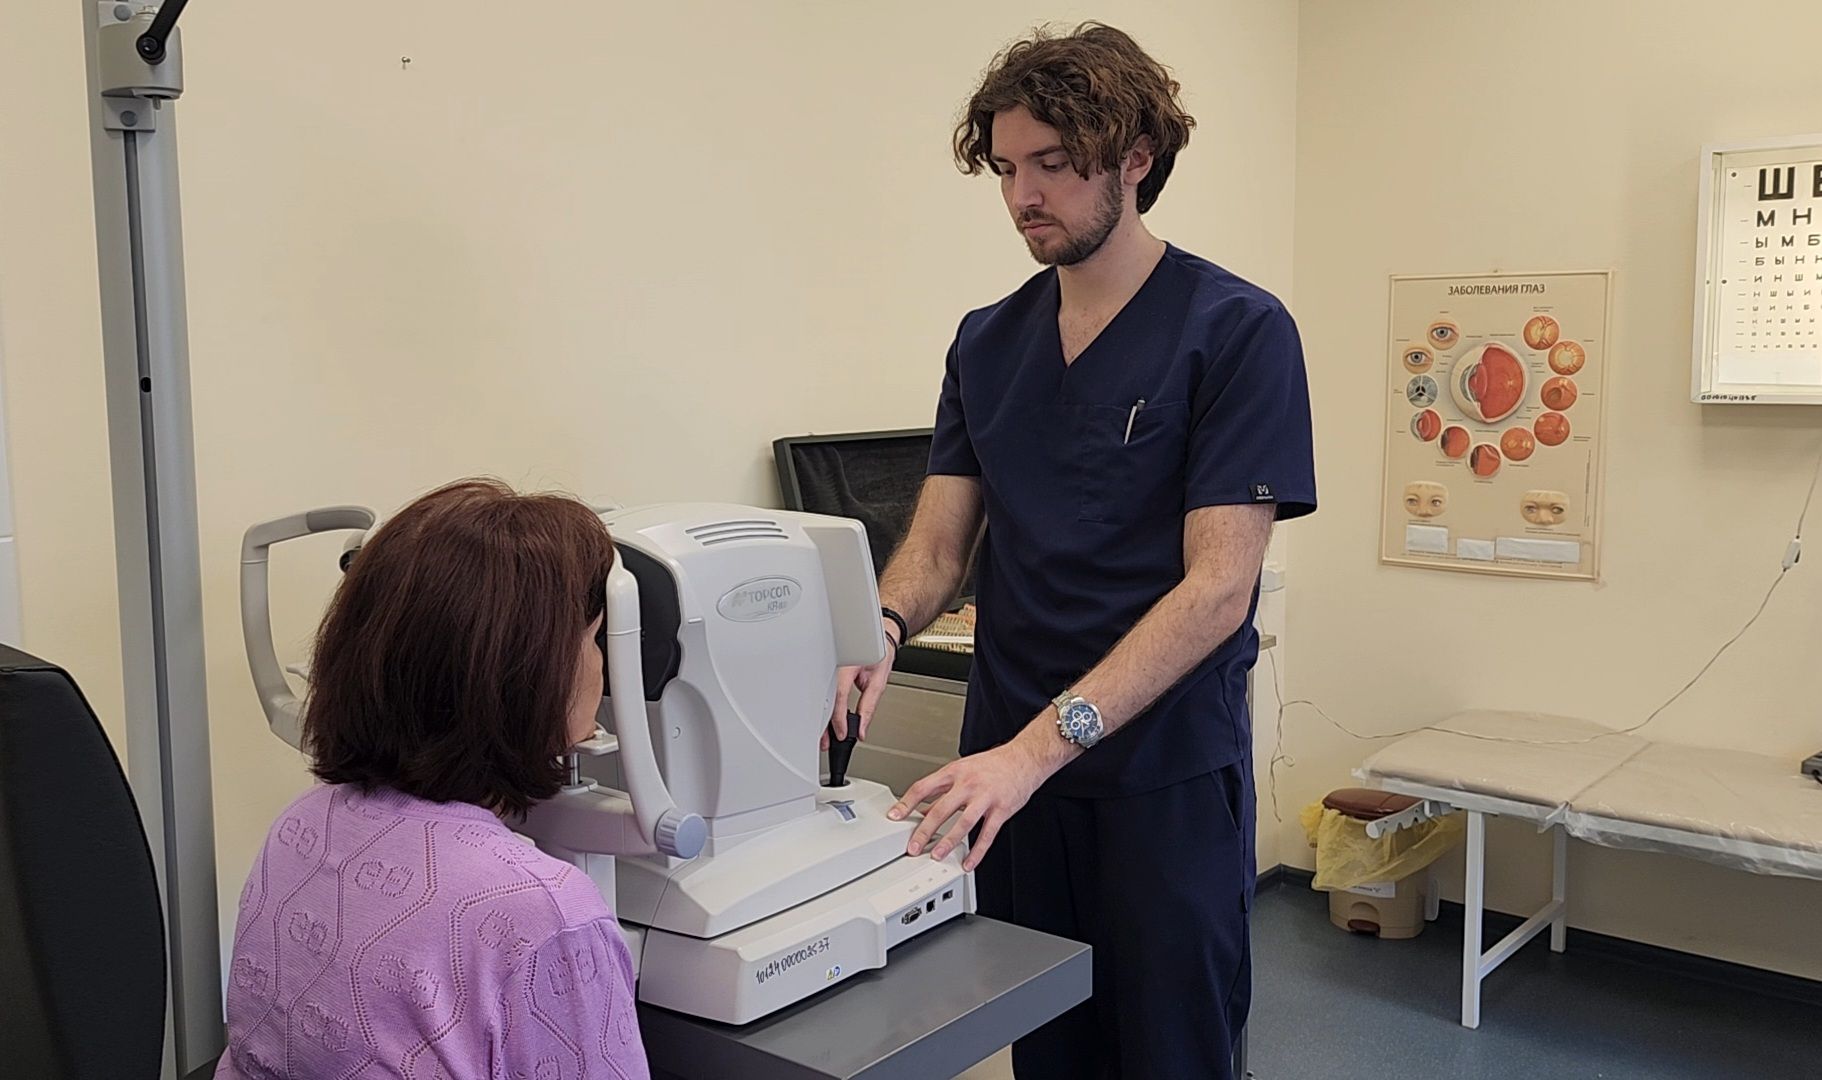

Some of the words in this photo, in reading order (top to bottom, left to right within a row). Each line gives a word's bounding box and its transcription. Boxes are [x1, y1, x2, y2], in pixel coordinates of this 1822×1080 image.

[1758, 166, 1796, 201] Ш
[1756, 209, 1776, 228] М
[1792, 207, 1812, 226] Н
[1755, 236, 1769, 249] Ы
[1781, 235, 1795, 248] М
[1807, 233, 1822, 247] Б
[1754, 256, 1765, 267] Б
[1774, 255, 1785, 266] Ы
[1794, 255, 1805, 265] Н
[1753, 275, 1763, 283] И
[1773, 274, 1783, 283] Н
[1448, 284, 1519, 296] ЗАБОЛЕВАНИЯ
[1520, 283, 1545, 294] ГЛАЗ
